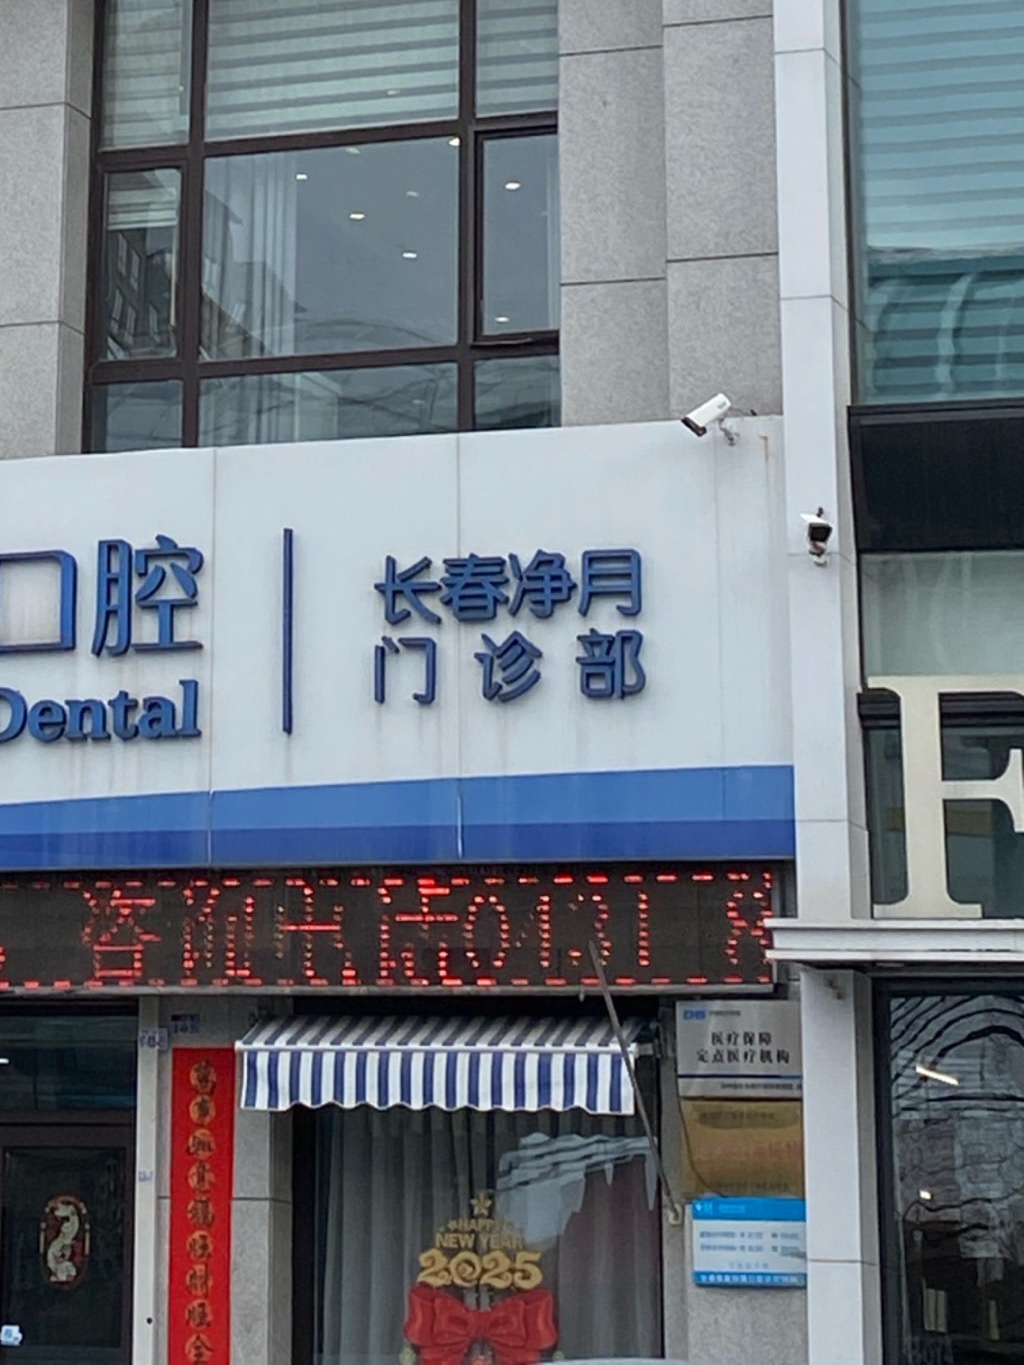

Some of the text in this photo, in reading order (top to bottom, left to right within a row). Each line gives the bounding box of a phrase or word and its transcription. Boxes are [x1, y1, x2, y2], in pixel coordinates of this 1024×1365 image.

[374, 548, 642, 625] 长春净月
[374, 628, 646, 705] 门诊部
[711, 1031, 772, 1046] 医疗保障
[697, 1049, 791, 1065] 定点医疗机构
[436, 1232, 523, 1250] NEW YEAR
[416, 1248, 543, 1290] 2025
